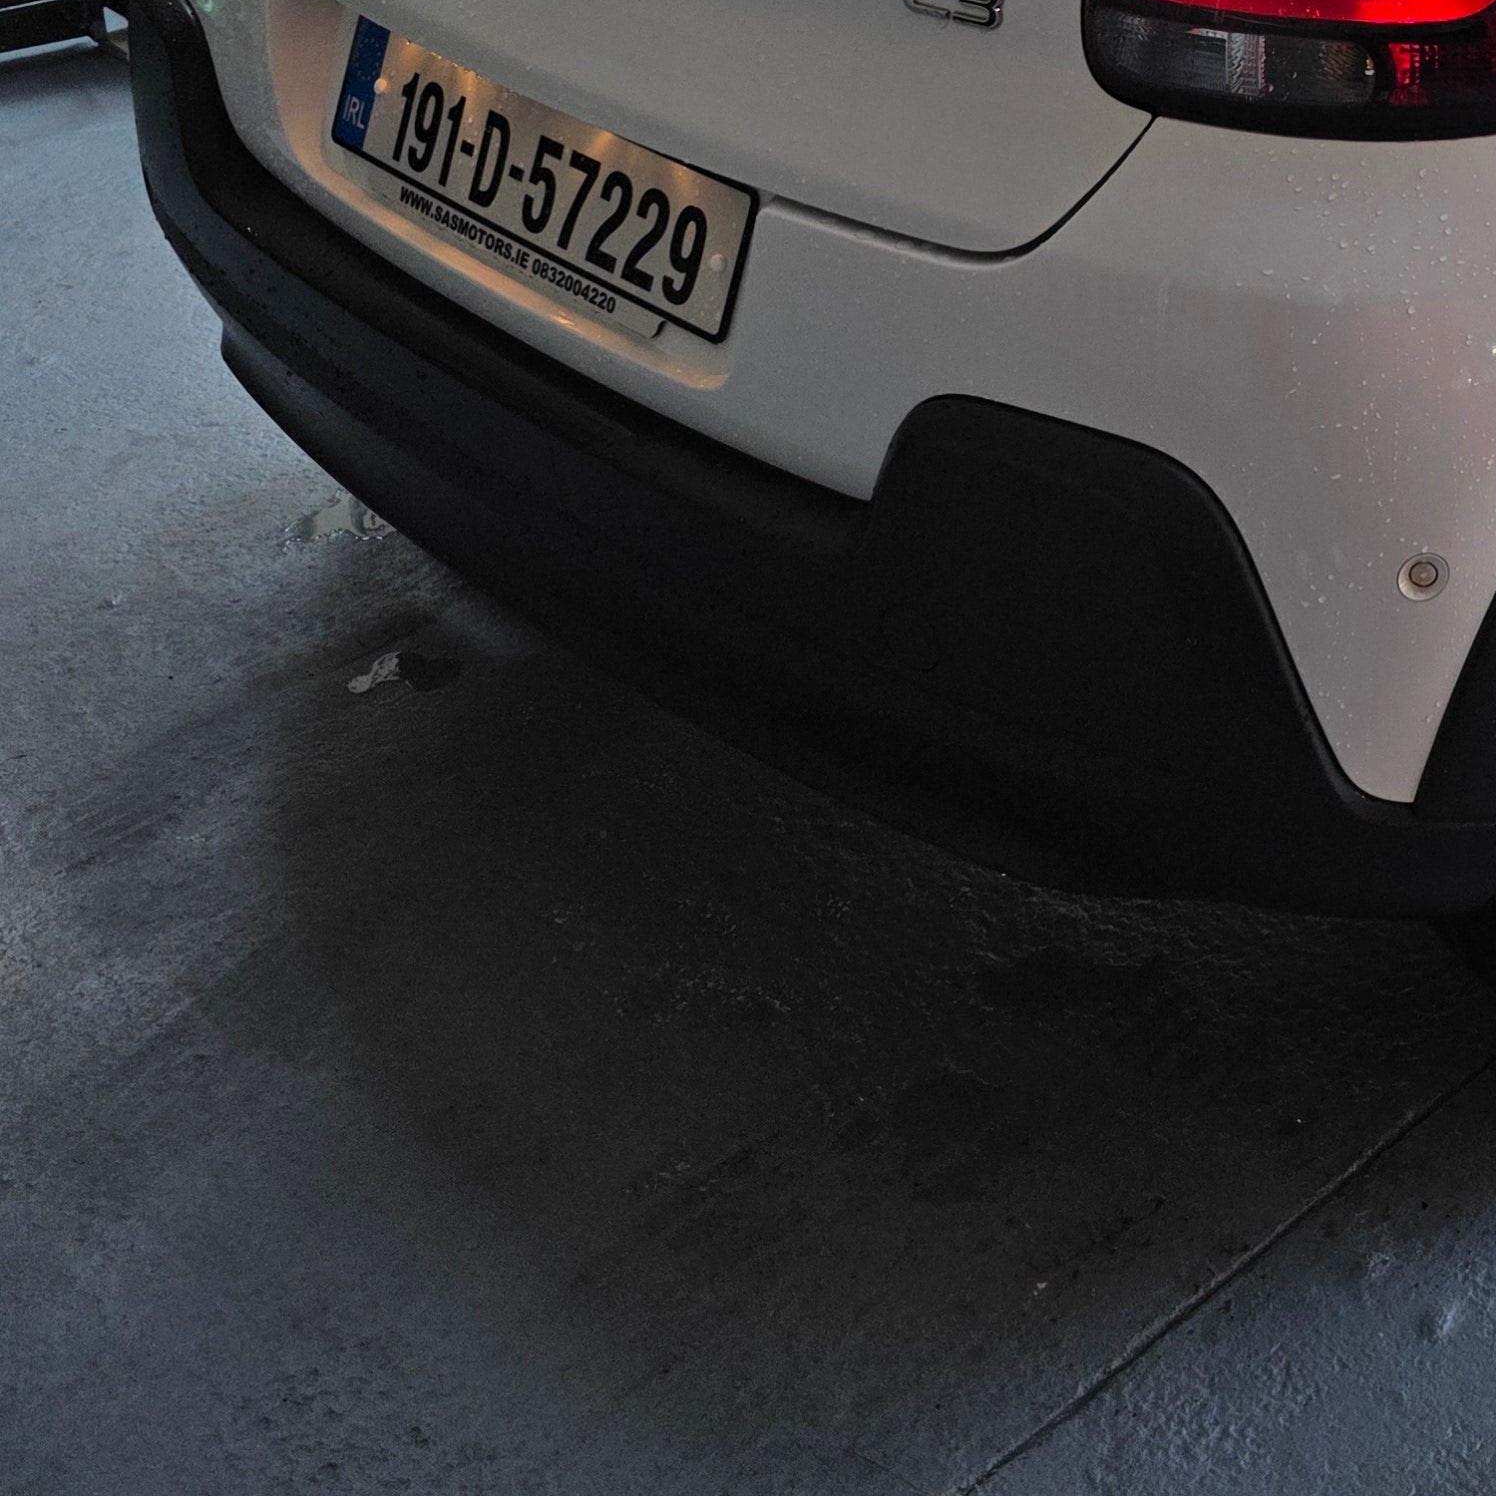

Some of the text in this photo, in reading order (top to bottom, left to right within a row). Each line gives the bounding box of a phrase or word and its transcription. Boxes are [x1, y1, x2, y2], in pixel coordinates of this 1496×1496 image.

[342, 94, 366, 131] IRL
[392, 71, 708, 306] 191-D-57229
[400, 186, 616, 314] WWW.SASMOTORS.IE 0832004220
